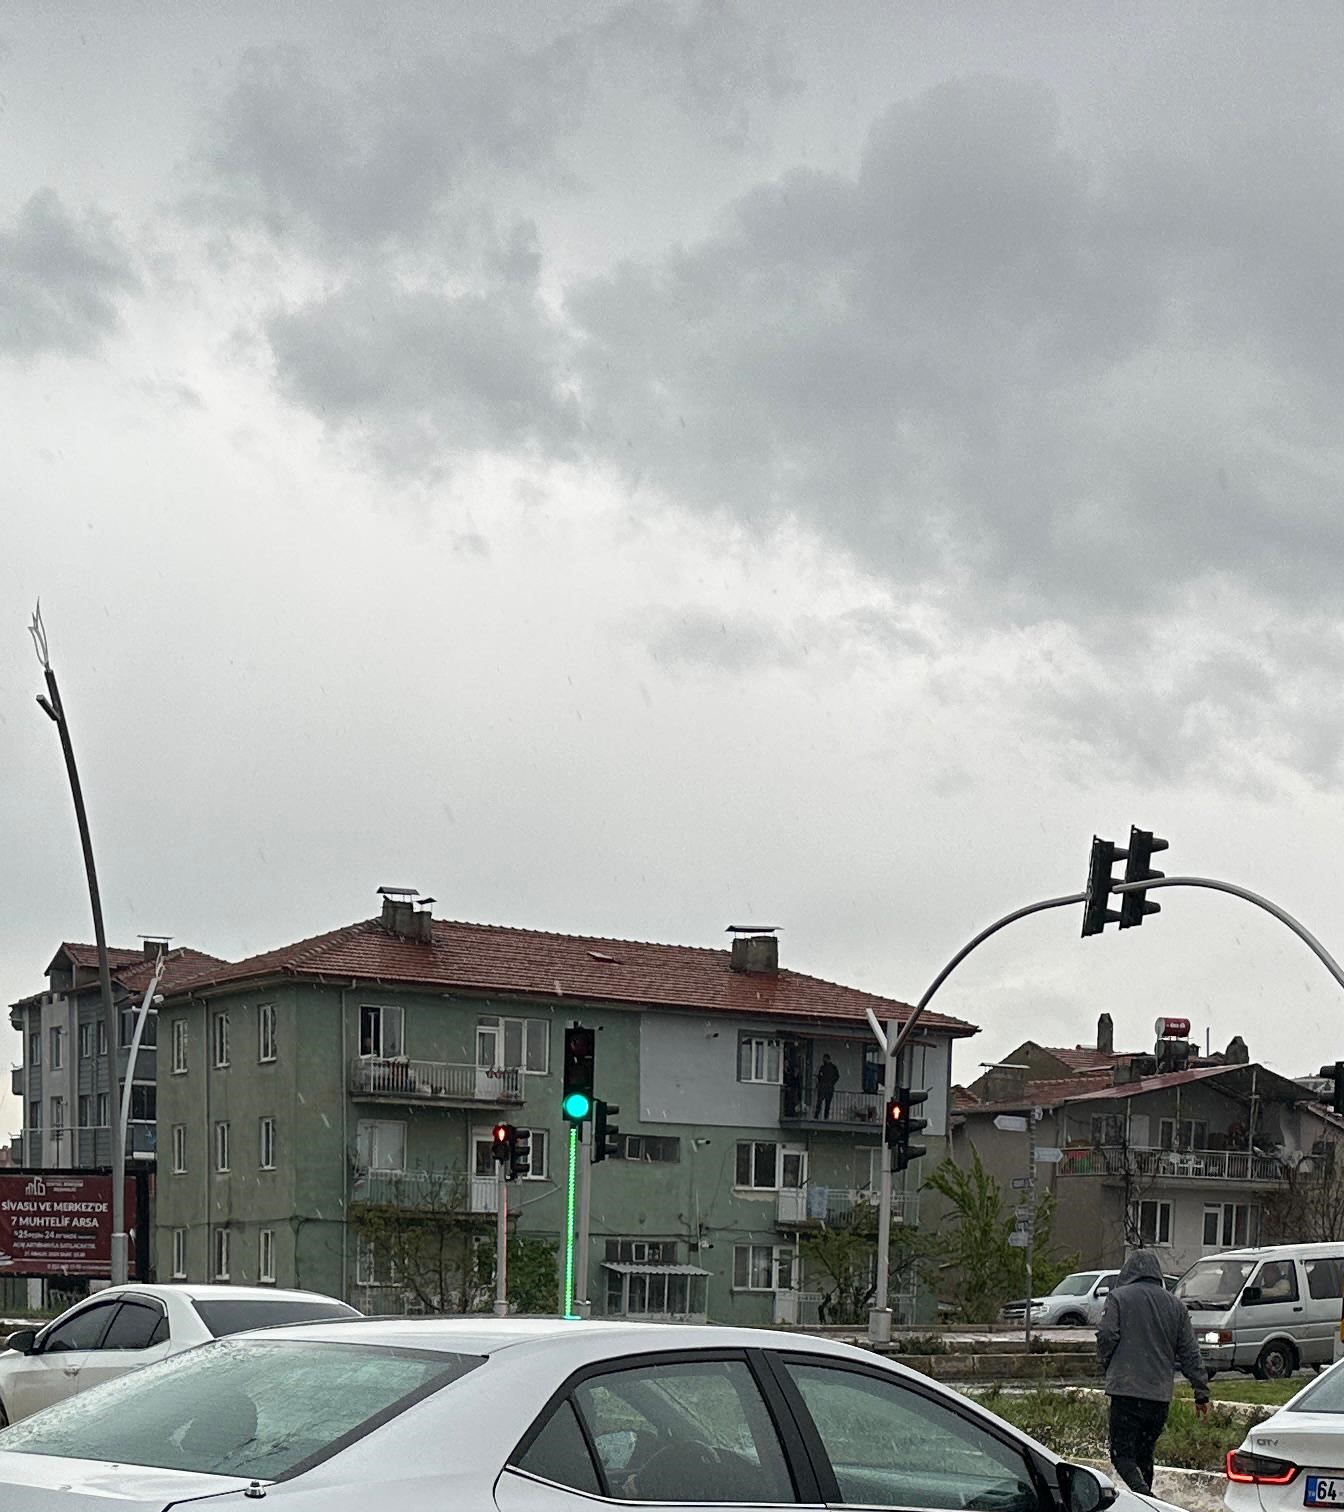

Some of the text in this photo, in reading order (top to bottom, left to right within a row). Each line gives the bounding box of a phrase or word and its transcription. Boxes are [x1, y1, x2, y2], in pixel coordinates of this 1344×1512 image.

[1, 1200, 108, 1212] SİVASLI VE MERKEZ'DE
[10, 1215, 99, 1228] 7 MUHTELİF ARSA
[1256, 1438, 1279, 1448] CITY
[1317, 1480, 1337, 1501] 64
